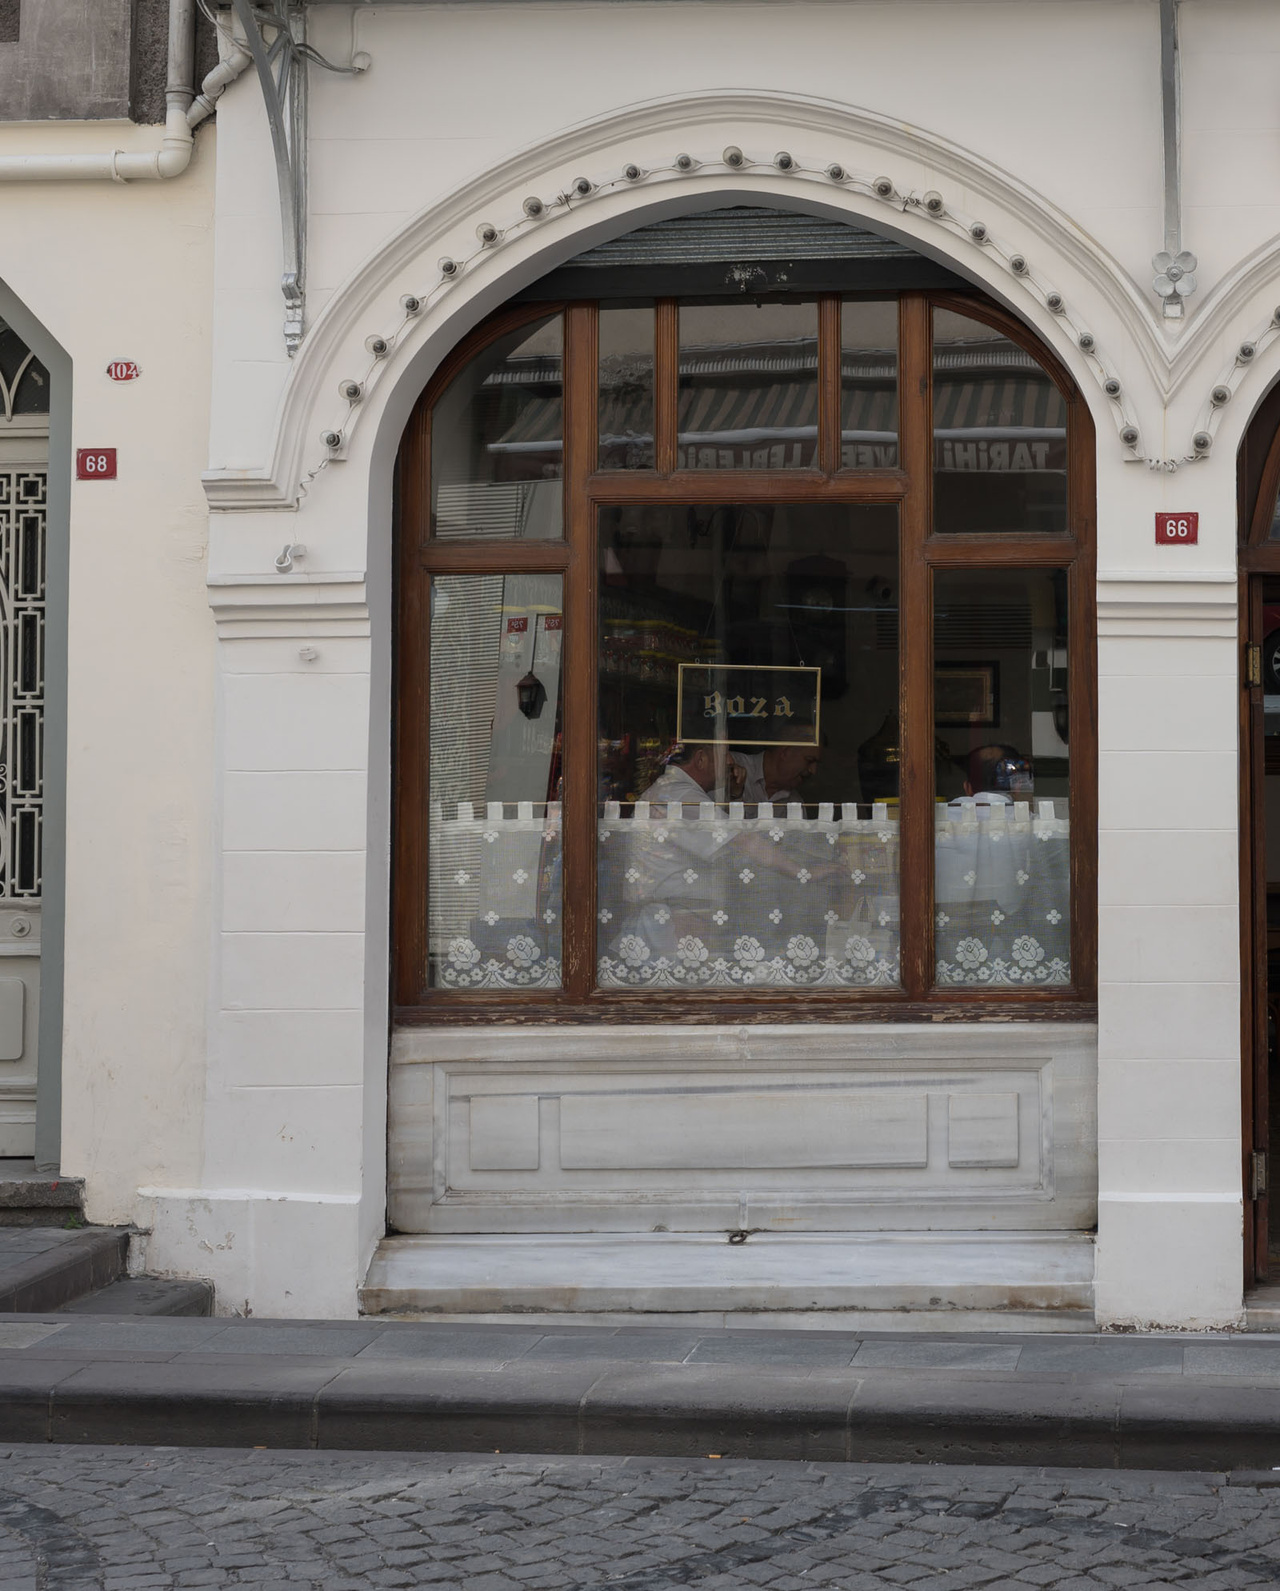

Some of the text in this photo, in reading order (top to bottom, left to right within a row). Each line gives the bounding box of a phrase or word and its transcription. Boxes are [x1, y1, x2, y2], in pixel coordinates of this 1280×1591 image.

[109, 363, 139, 379] 104
[86, 455, 107, 472] 68
[1166, 519, 1188, 537] 66
[704, 690, 795, 718] Boza
